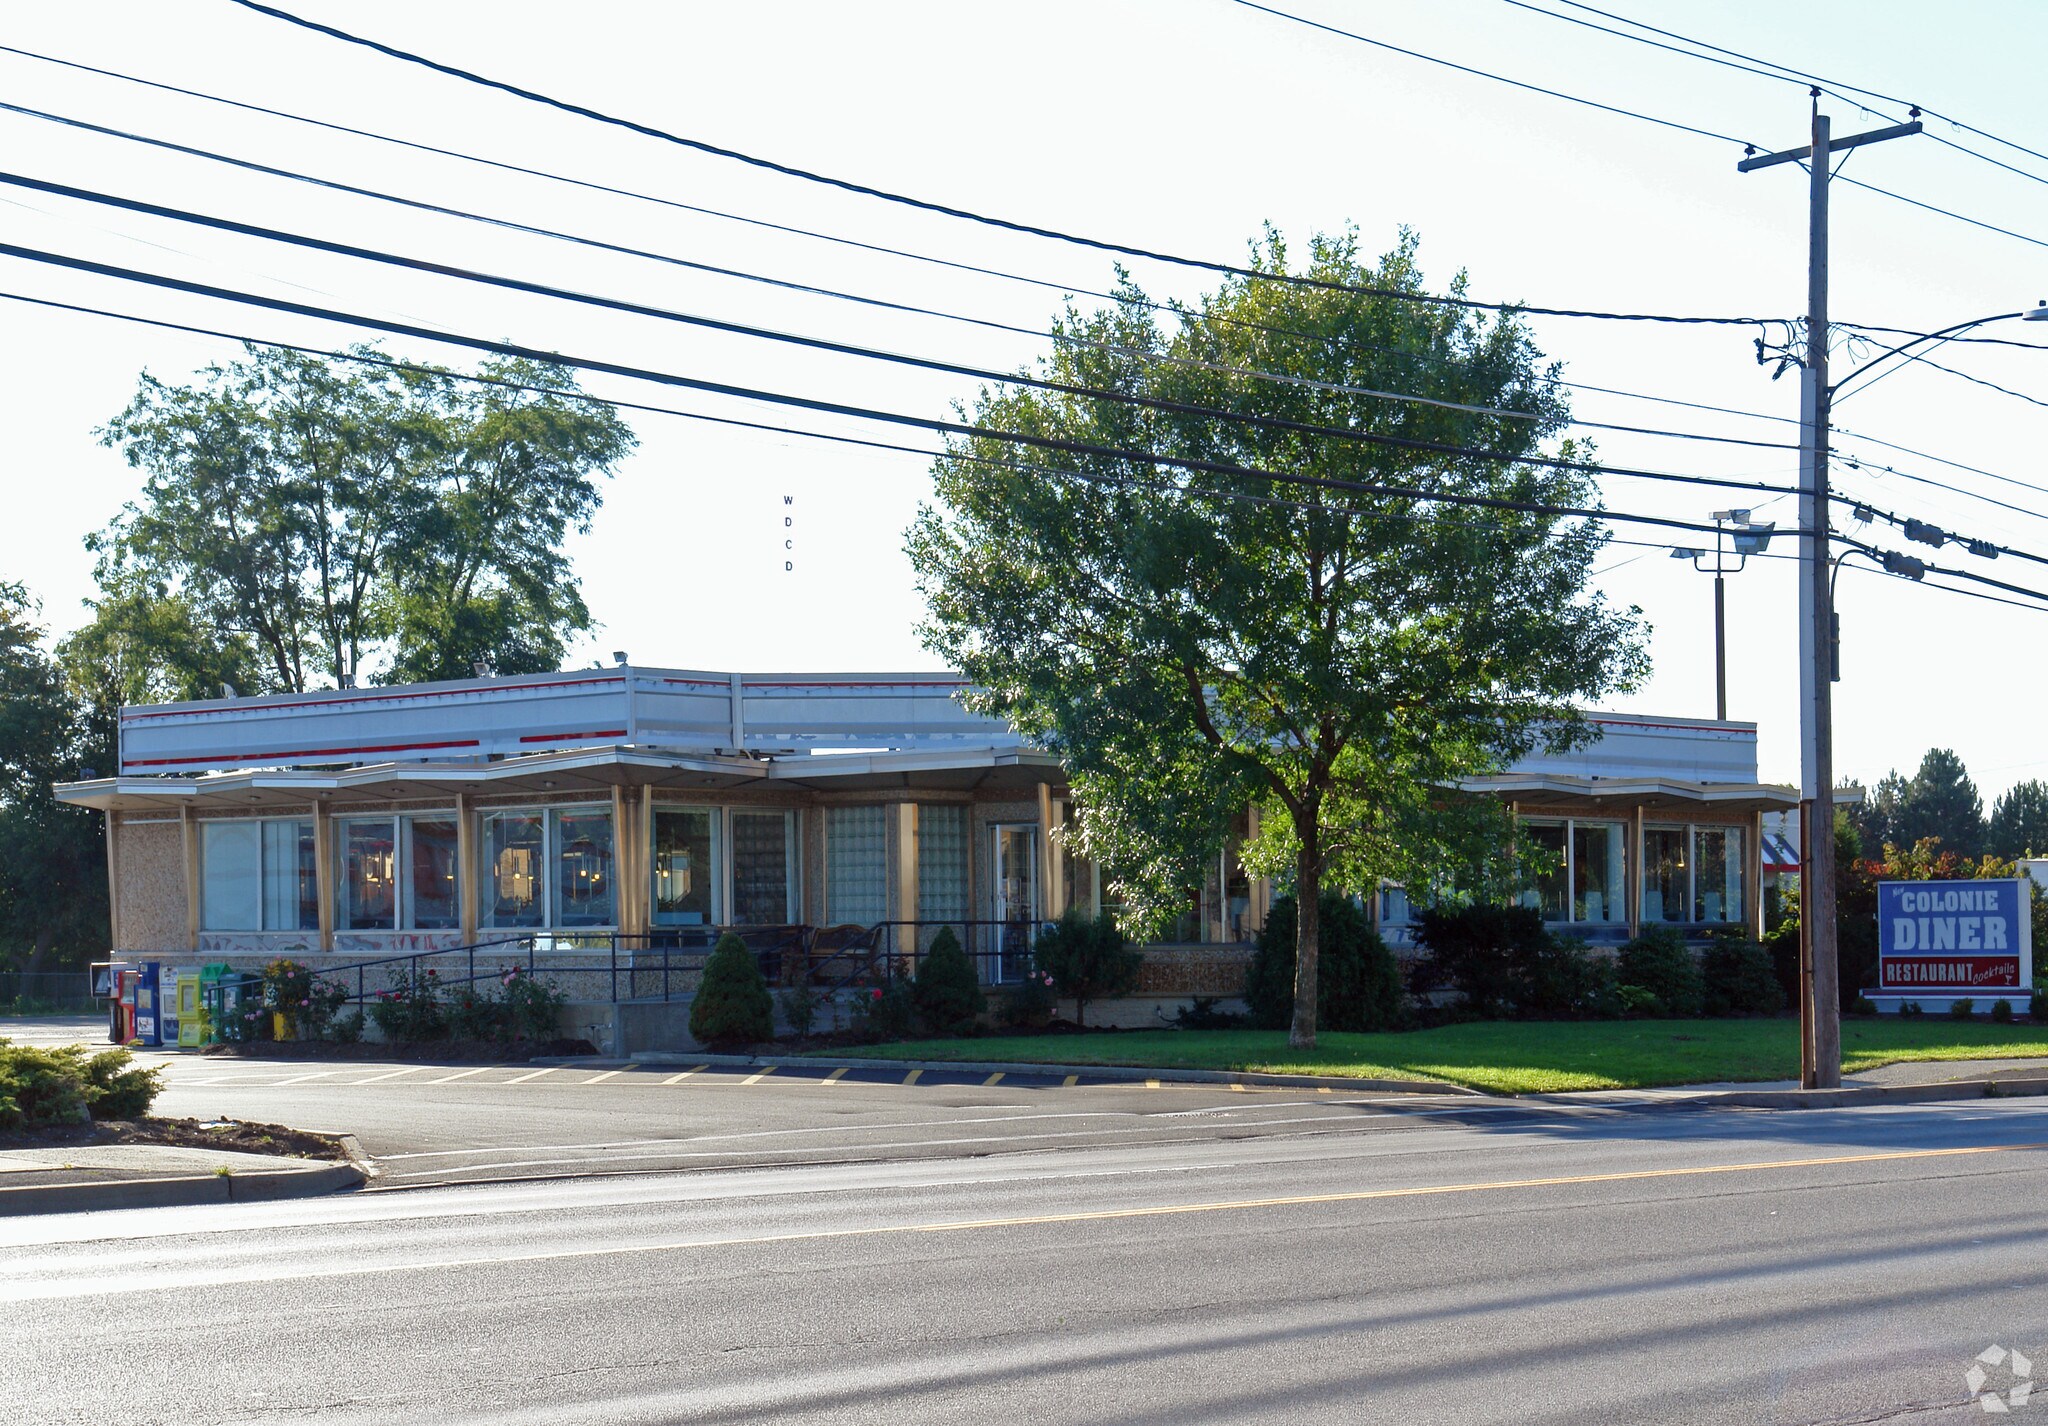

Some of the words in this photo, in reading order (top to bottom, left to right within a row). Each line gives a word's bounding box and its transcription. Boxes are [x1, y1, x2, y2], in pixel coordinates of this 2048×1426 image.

[1901, 890, 1998, 913] COLONIE
[1893, 916, 2008, 950] DINER
[1886, 963, 1973, 982] RESTAURANT
